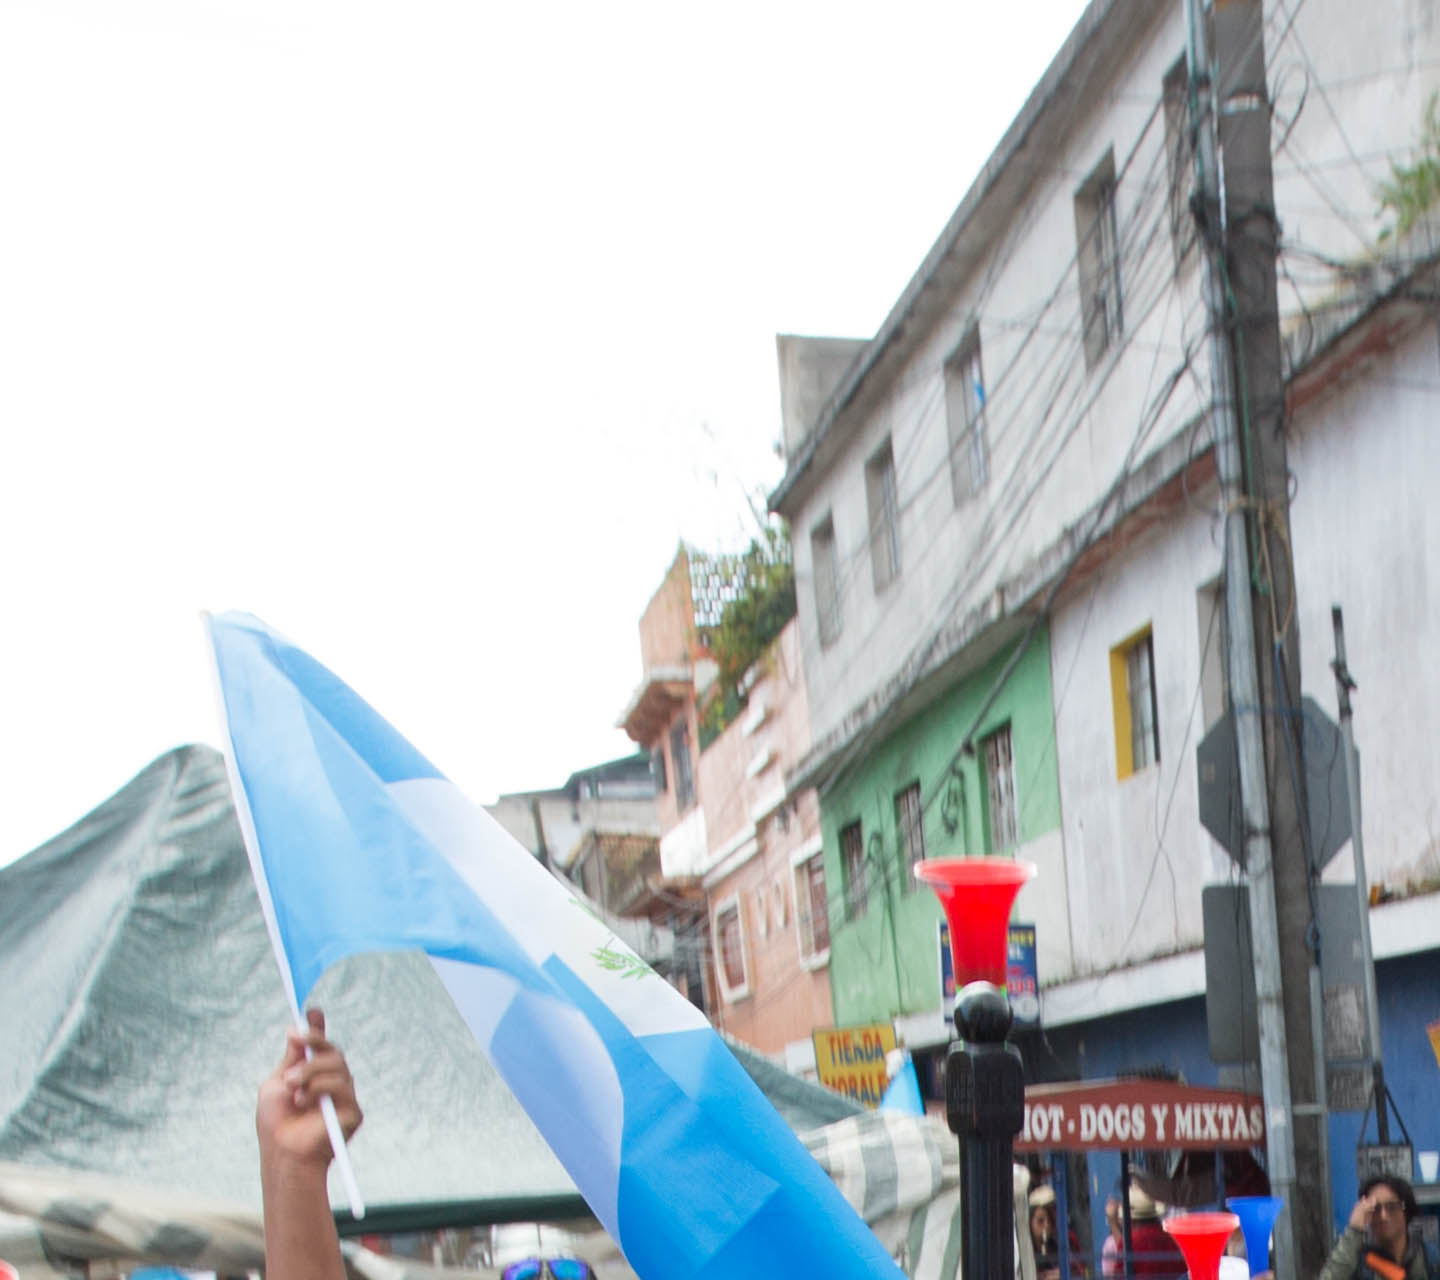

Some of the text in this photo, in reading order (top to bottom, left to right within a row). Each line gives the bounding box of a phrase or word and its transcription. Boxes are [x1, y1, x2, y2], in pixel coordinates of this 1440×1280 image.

[828, 1031, 884, 1066] TIENDA
[1079, 1103, 1146, 1143] DOGS
[1151, 1103, 1169, 1143] Y
[1174, 1102, 1264, 1142] MIXTAS
